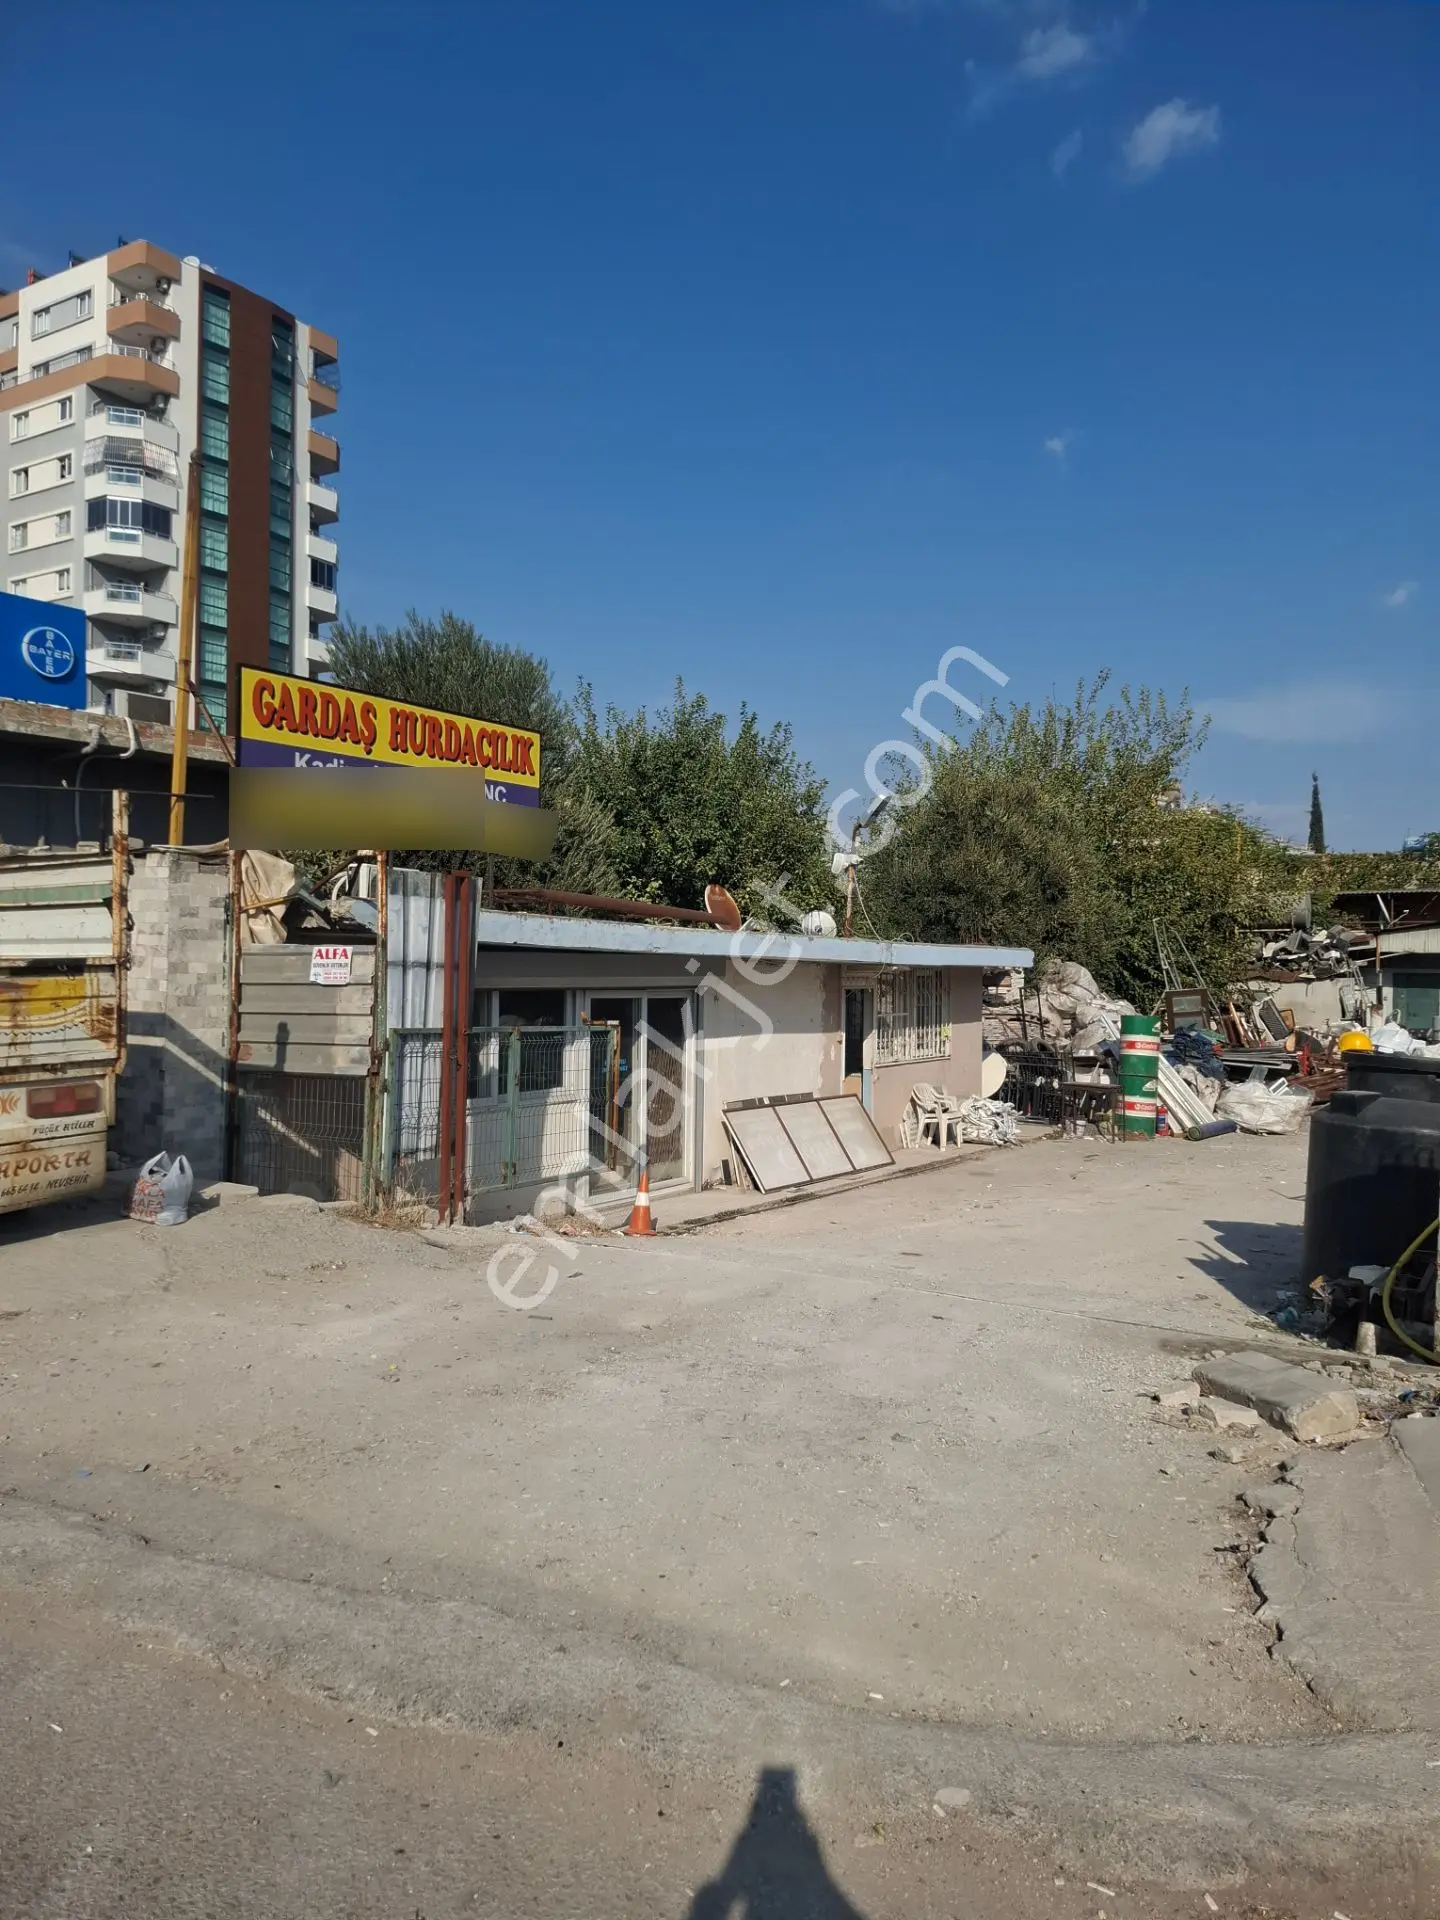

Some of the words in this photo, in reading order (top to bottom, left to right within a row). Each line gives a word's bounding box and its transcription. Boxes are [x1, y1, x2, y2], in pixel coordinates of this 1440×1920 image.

[29, 644, 71, 661] BAYER
[251, 678, 377, 755] GARDAŞ
[388, 707, 536, 777] HURDACILIK
[314, 947, 349, 960] ALFA
